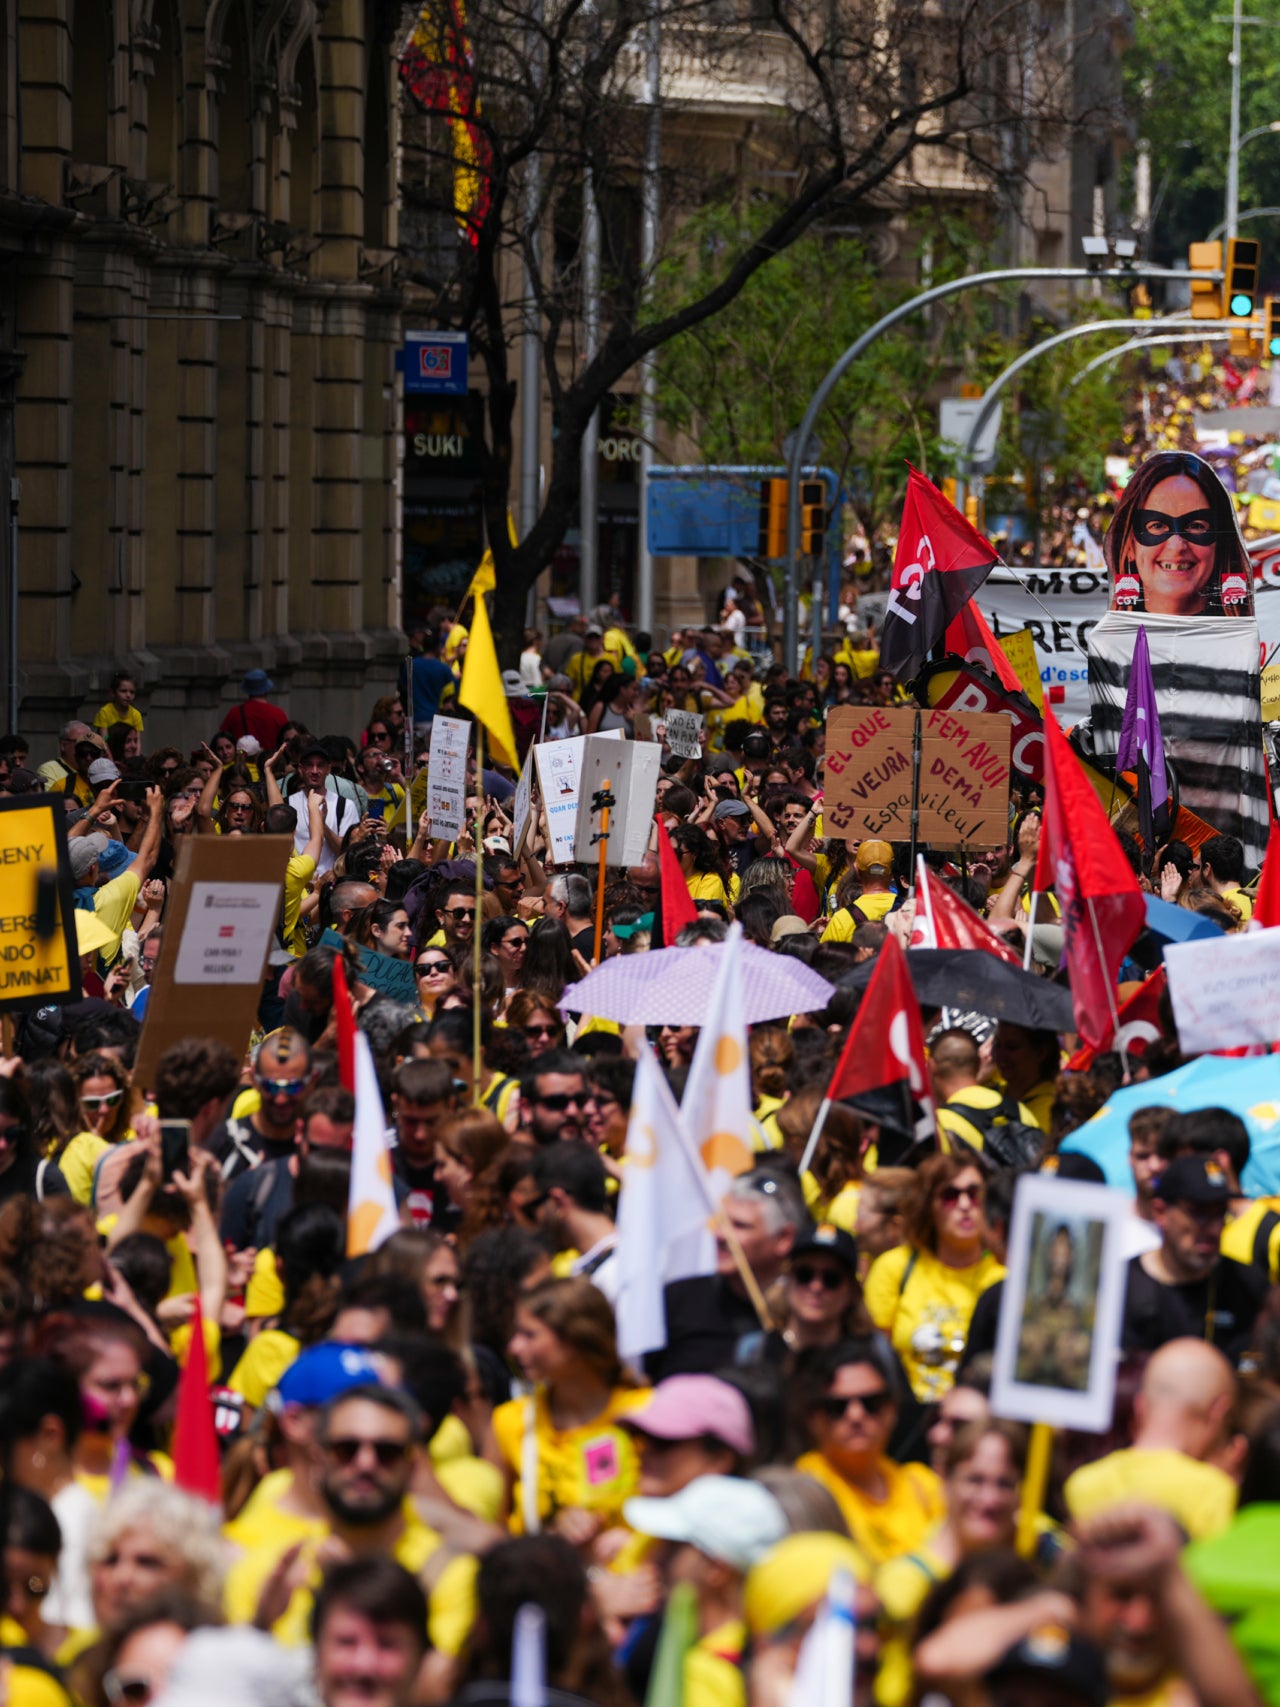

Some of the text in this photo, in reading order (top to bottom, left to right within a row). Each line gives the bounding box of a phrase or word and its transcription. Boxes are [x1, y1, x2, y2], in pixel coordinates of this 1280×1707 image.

[413, 433, 463, 458] SUKI
[1116, 596, 1139, 606] CGT
[1223, 595, 1245, 605] CGT
[826, 709, 1009, 789] EL QUE FEM AVUI
[830, 746, 984, 829] ES VEURÀ DEMÀ
